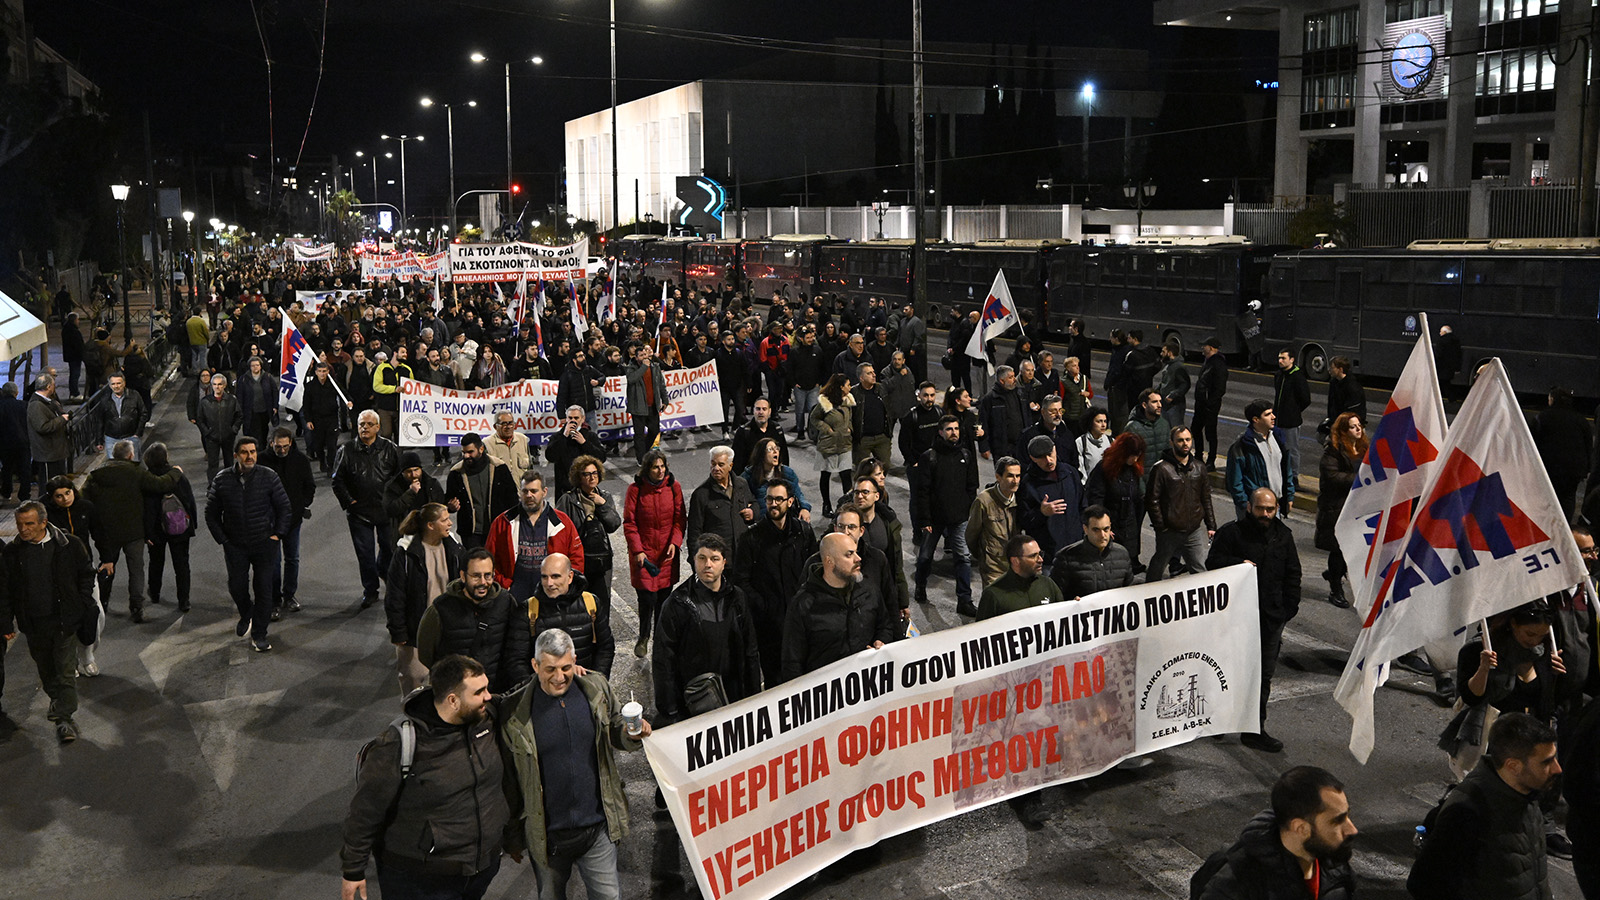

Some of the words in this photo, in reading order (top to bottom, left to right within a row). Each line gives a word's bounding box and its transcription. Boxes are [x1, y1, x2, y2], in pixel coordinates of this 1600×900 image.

[458, 248, 474, 257] ΓΙΑ
[477, 247, 496, 256] ΤΟΥ
[499, 246, 538, 256] ΑΦΕΝΤΗ
[542, 249, 554, 258] ΤΟ
[558, 246, 574, 257] ΦΑΙ
[453, 261, 466, 270] ΝΑ
[469, 259, 539, 270] ΣΚΟΤΩΝΟΝΤΑΙ
[453, 273, 504, 282] ΠΑΝΕΛΛΗΝΙΟΣ
[403, 400, 428, 413] ΜΑΣ
[434, 401, 485, 416] ΡΙΧΝΟΥΝ
[491, 401, 521, 414] ΣΤΗΝ
[527, 400, 557, 414] ΑΝΕΧ
[594, 396, 628, 410] ΟΙΡΑΖ
[668, 380, 718, 400] ΚΟΥΠΟΝΙΑ
[404, 381, 432, 396] ΟΛΑ
[442, 388, 458, 398] ΤΑ
[467, 382, 534, 400] ΠΑΡΑΣΙΤΑ
[542, 383, 559, 396] ΠΟ
[605, 378, 622, 393] ΝΕ
[442, 418, 491, 431] ΤΩΡΑ
[513, 415, 565, 430] ΑΪΚΟ
[685, 706, 773, 772] ΚΑΜΙΑ
[778, 661, 895, 734] ΕΜΠΛΟΚΗ
[901, 651, 956, 688] στον
[960, 601, 1140, 674] ΙΜΠΕΡΙΑΛΙΣΤΙΚΟ
[1143, 582, 1230, 628] ΠΟΛΕΜΟ
[1140, 670, 1162, 710] ΚΛΑΔΙΚΟ
[1162, 652, 1200, 672] ΣΩΜΑΤΕΙΟ
[1201, 653, 1228, 692] ΕΝΕΡΓΕΙΑΣ
[1152, 726, 1179, 740] Σ.Ε.Ε.Ν.
[688, 737, 830, 838] ΕΝΕΡΓΕΙΑ
[837, 697, 954, 768] ΦΘΗΝΗ
[962, 688, 1007, 735] για
[1015, 678, 1043, 715] το
[1051, 655, 1106, 706] ΛΑΟ
[838, 771, 926, 832] στους
[934, 725, 1062, 798] ΜΙΣΘΟΥΣ
